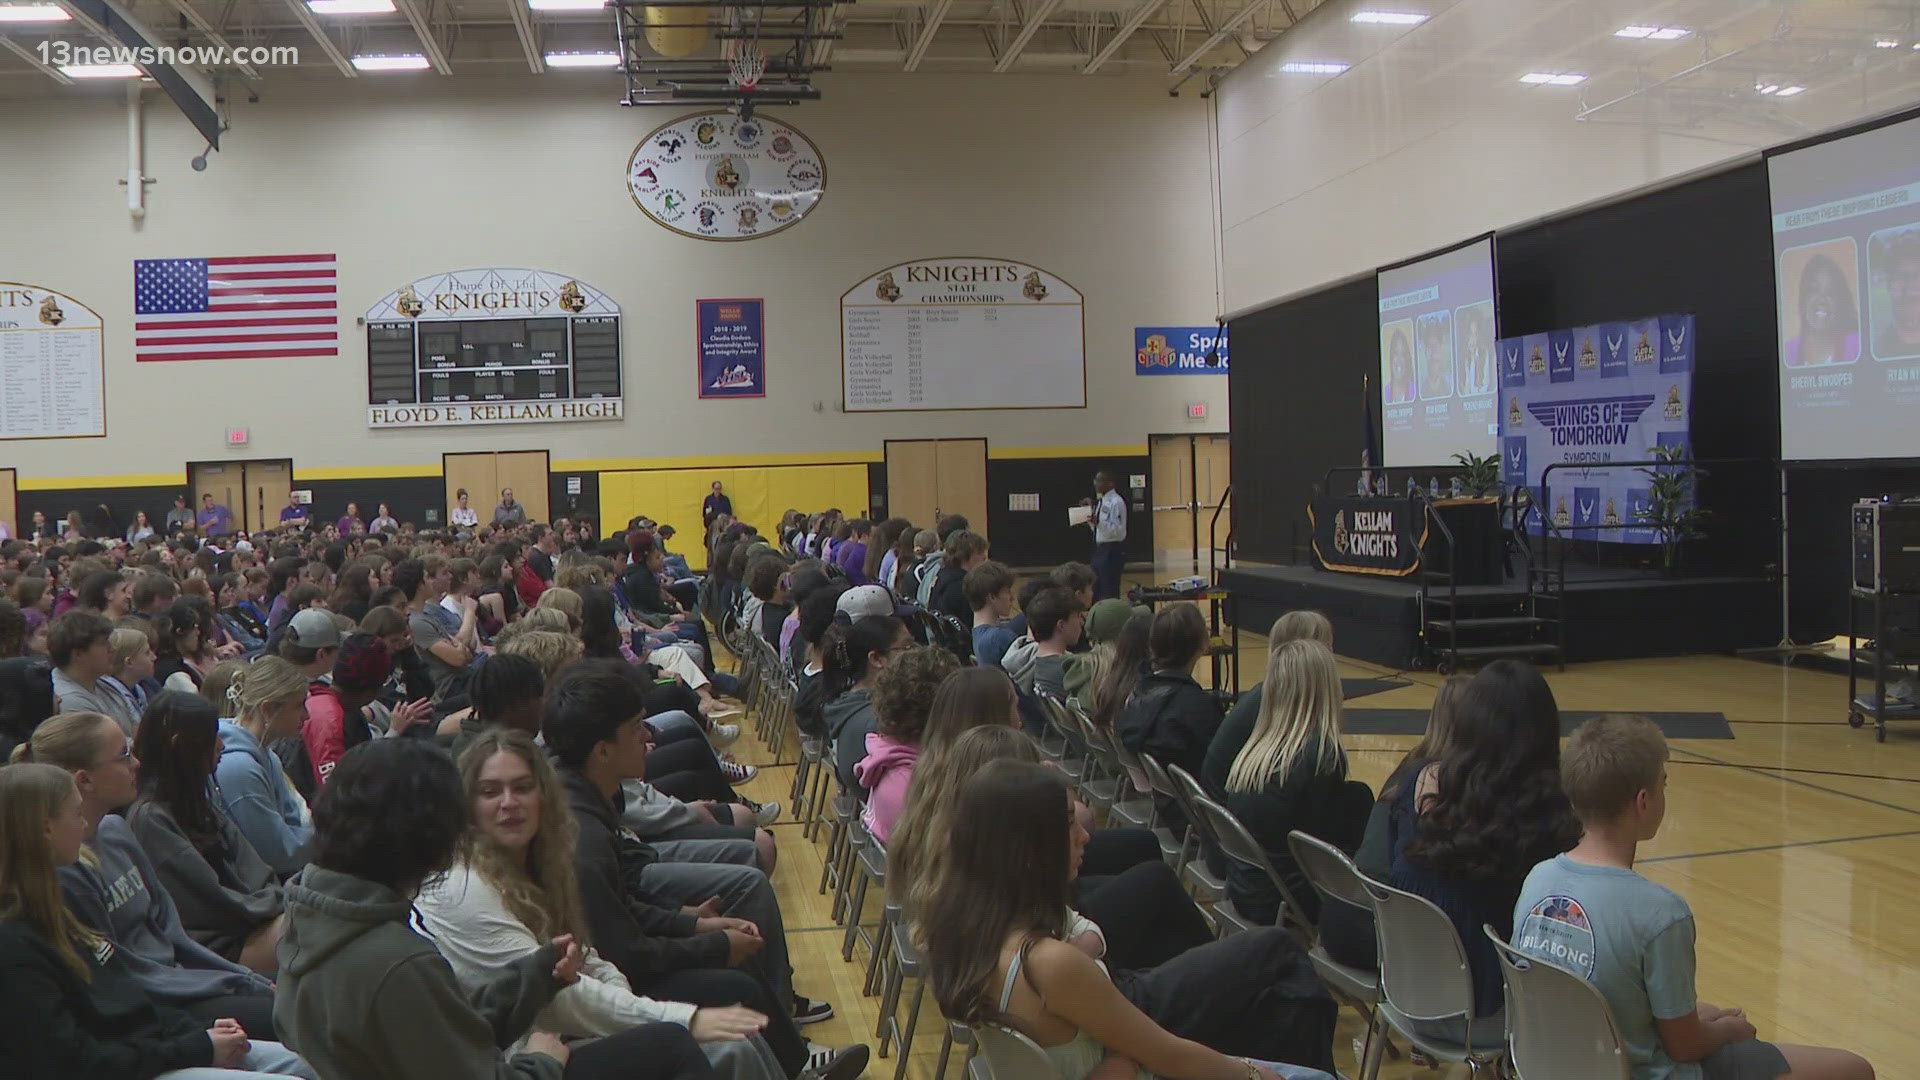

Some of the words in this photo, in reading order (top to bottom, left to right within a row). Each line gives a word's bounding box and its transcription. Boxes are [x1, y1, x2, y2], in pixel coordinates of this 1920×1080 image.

[654, 129, 687, 144] LANDSTOWN
[772, 129, 793, 137] SALEM
[694, 140, 721, 150] FALCONS
[733, 140, 760, 150] PATRIOTS
[634, 159, 660, 168] BAYSIDE
[658, 155, 682, 163] EAGLES
[634, 183, 660, 193] MARLINS
[655, 188, 674, 201] GREEN
[701, 189, 756, 198] KNIGHTS
[692, 201, 725, 215] KEMPSVILLE
[733, 201, 763, 213] TALLWOOD
[655, 210, 685, 223] STALLIONS
[697, 227, 719, 235] CHIEFS
[906, 265, 1018, 283] KNIGHTS
[450, 281, 483, 291] Home
[514, 279, 536, 289] The
[947, 284, 977, 292] STATE
[435, 291, 551, 310] KNIGHTS
[921, 295, 1006, 303] CHAMPIONSHIPS
[1138, 351, 1176, 368] CHKD
[1179, 353, 1229, 369] Meic
[1791, 375, 1817, 389] SHERYL
[1818, 372, 1853, 387] SWOOPES
[372, 407, 439, 423] FLOYD
[446, 407, 462, 421] E.
[470, 403, 553, 421] KELLAM
[561, 402, 617, 418] HIGH
[1556, 406, 1600, 426] WINGS
[1603, 403, 1620, 423] OF
[1550, 424, 1629, 446] TOMORROW
[1563, 452, 1611, 464] SYMPOSIUM
[1354, 511, 1392, 531] KELLAM
[1349, 533, 1398, 558] KNIGHTS
